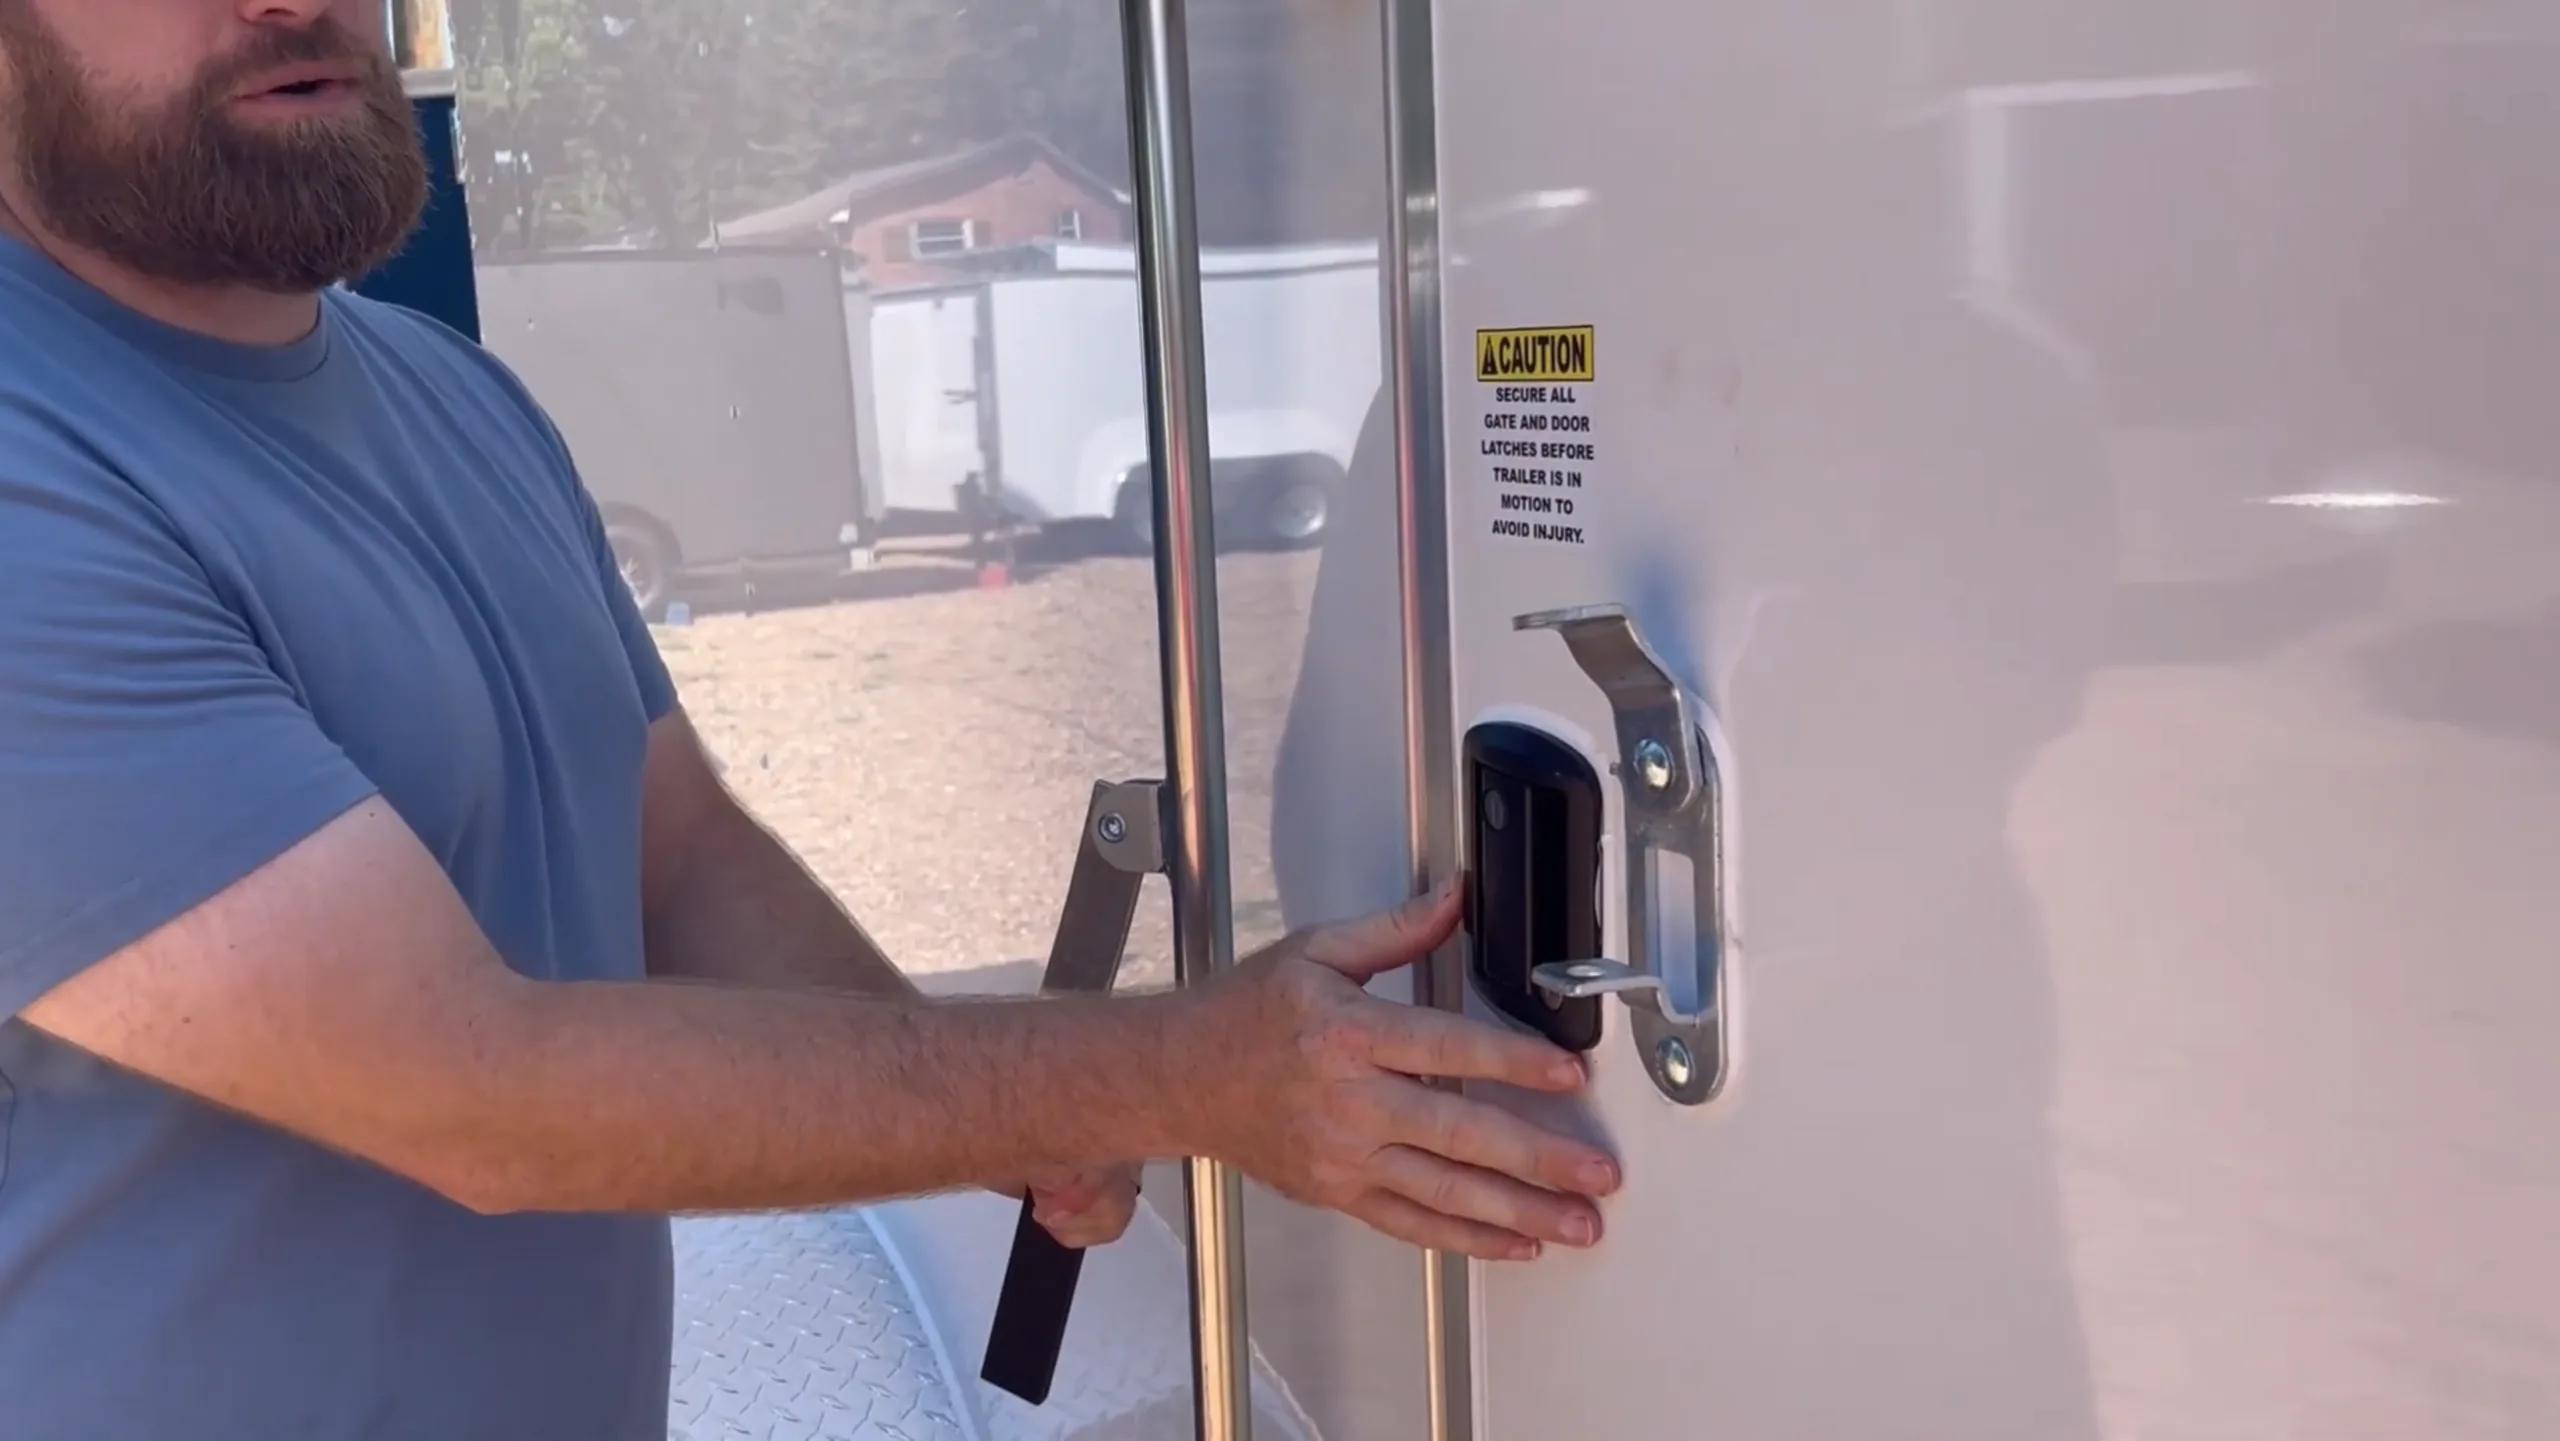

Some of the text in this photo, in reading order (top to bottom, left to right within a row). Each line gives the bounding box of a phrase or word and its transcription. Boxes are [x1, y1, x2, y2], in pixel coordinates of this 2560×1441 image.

[1499, 334, 1585, 373] CAUTION
[1496, 387, 1575, 403] SECURE ALL
[1484, 414, 1590, 431] GATE AND DOOR
[1481, 440, 1594, 460] LATCHES BEFORE
[1493, 467, 1581, 487] TRAILER IS IN
[1501, 494, 1573, 515] MOTION TO
[1492, 520, 1584, 544] AVOID INJURY.
